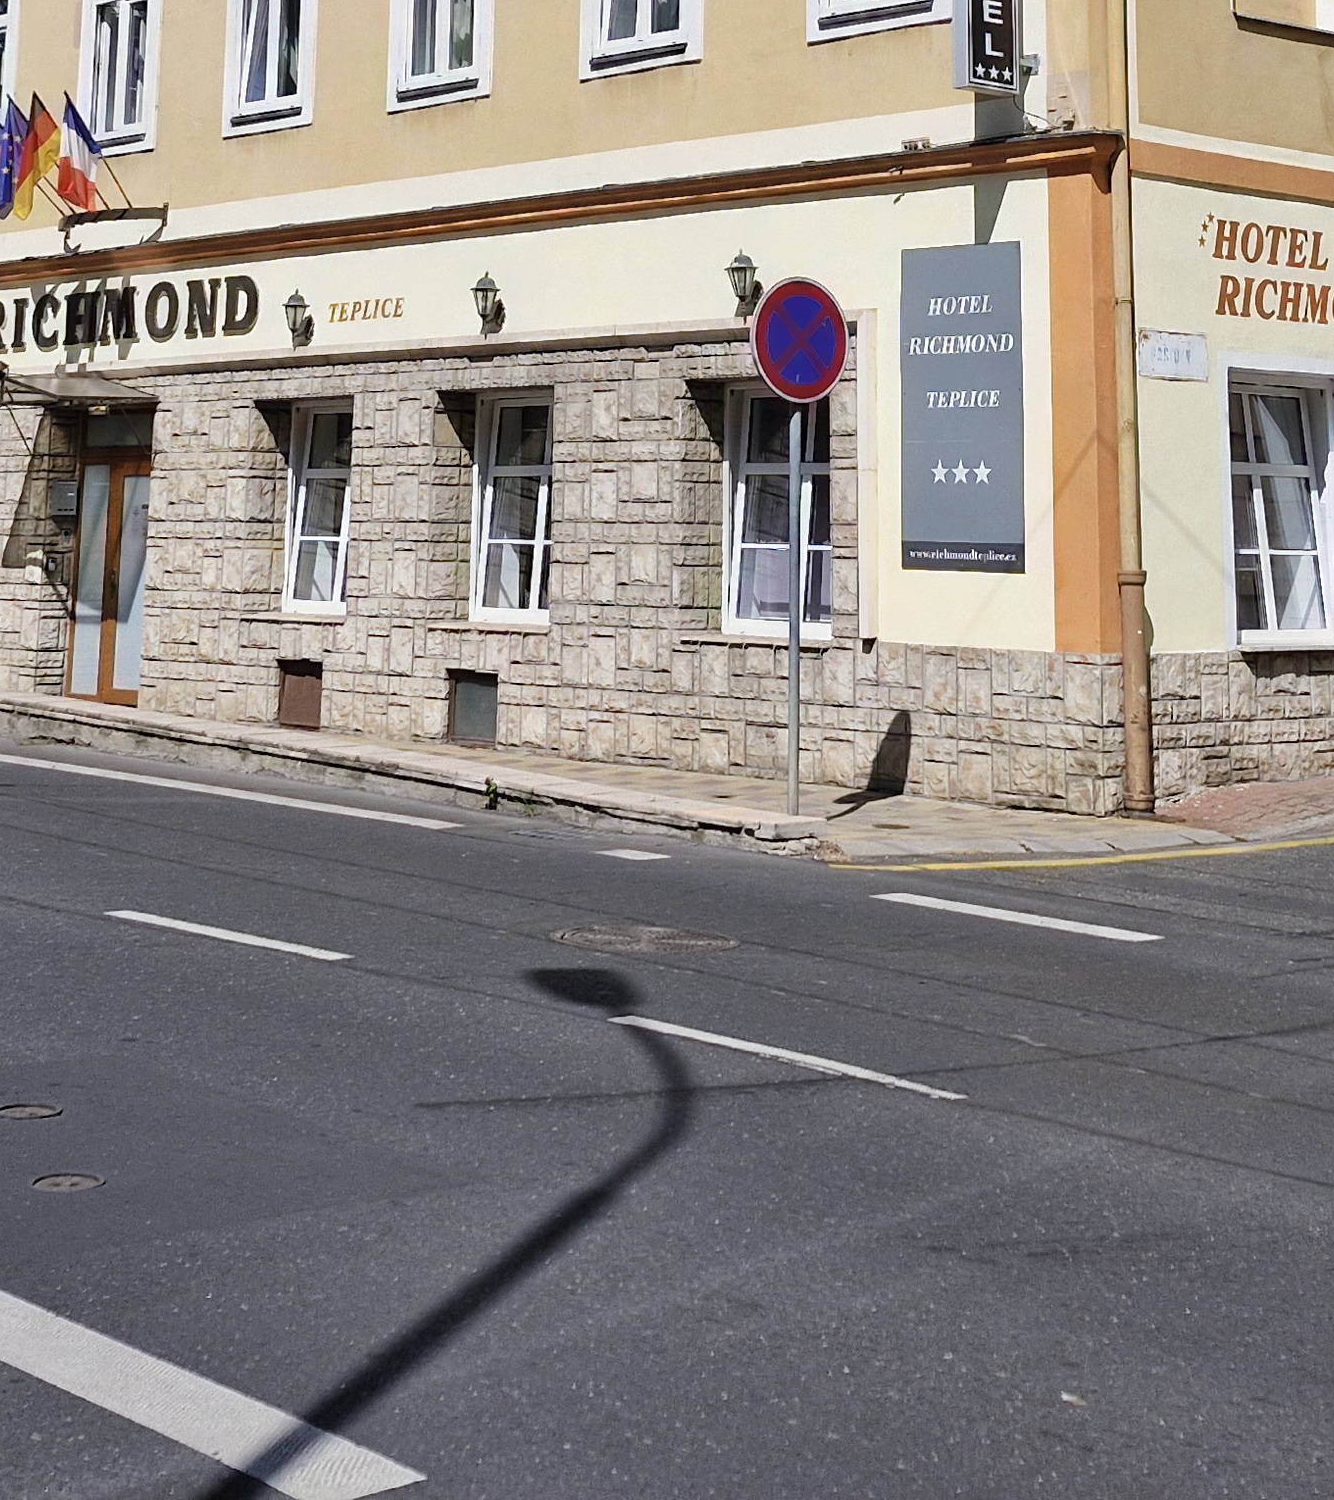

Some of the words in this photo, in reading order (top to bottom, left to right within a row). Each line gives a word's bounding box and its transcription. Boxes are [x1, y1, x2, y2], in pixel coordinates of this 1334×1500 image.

[1212, 219, 1329, 271] HOTEL
[328, 297, 405, 323] TEPLICE
[927, 294, 993, 317] HOTEL
[908, 333, 1014, 356] RICHMOND
[927, 390, 1000, 409] TEPLICE
[909, 548, 1017, 563] www.richmondteplice.cz
